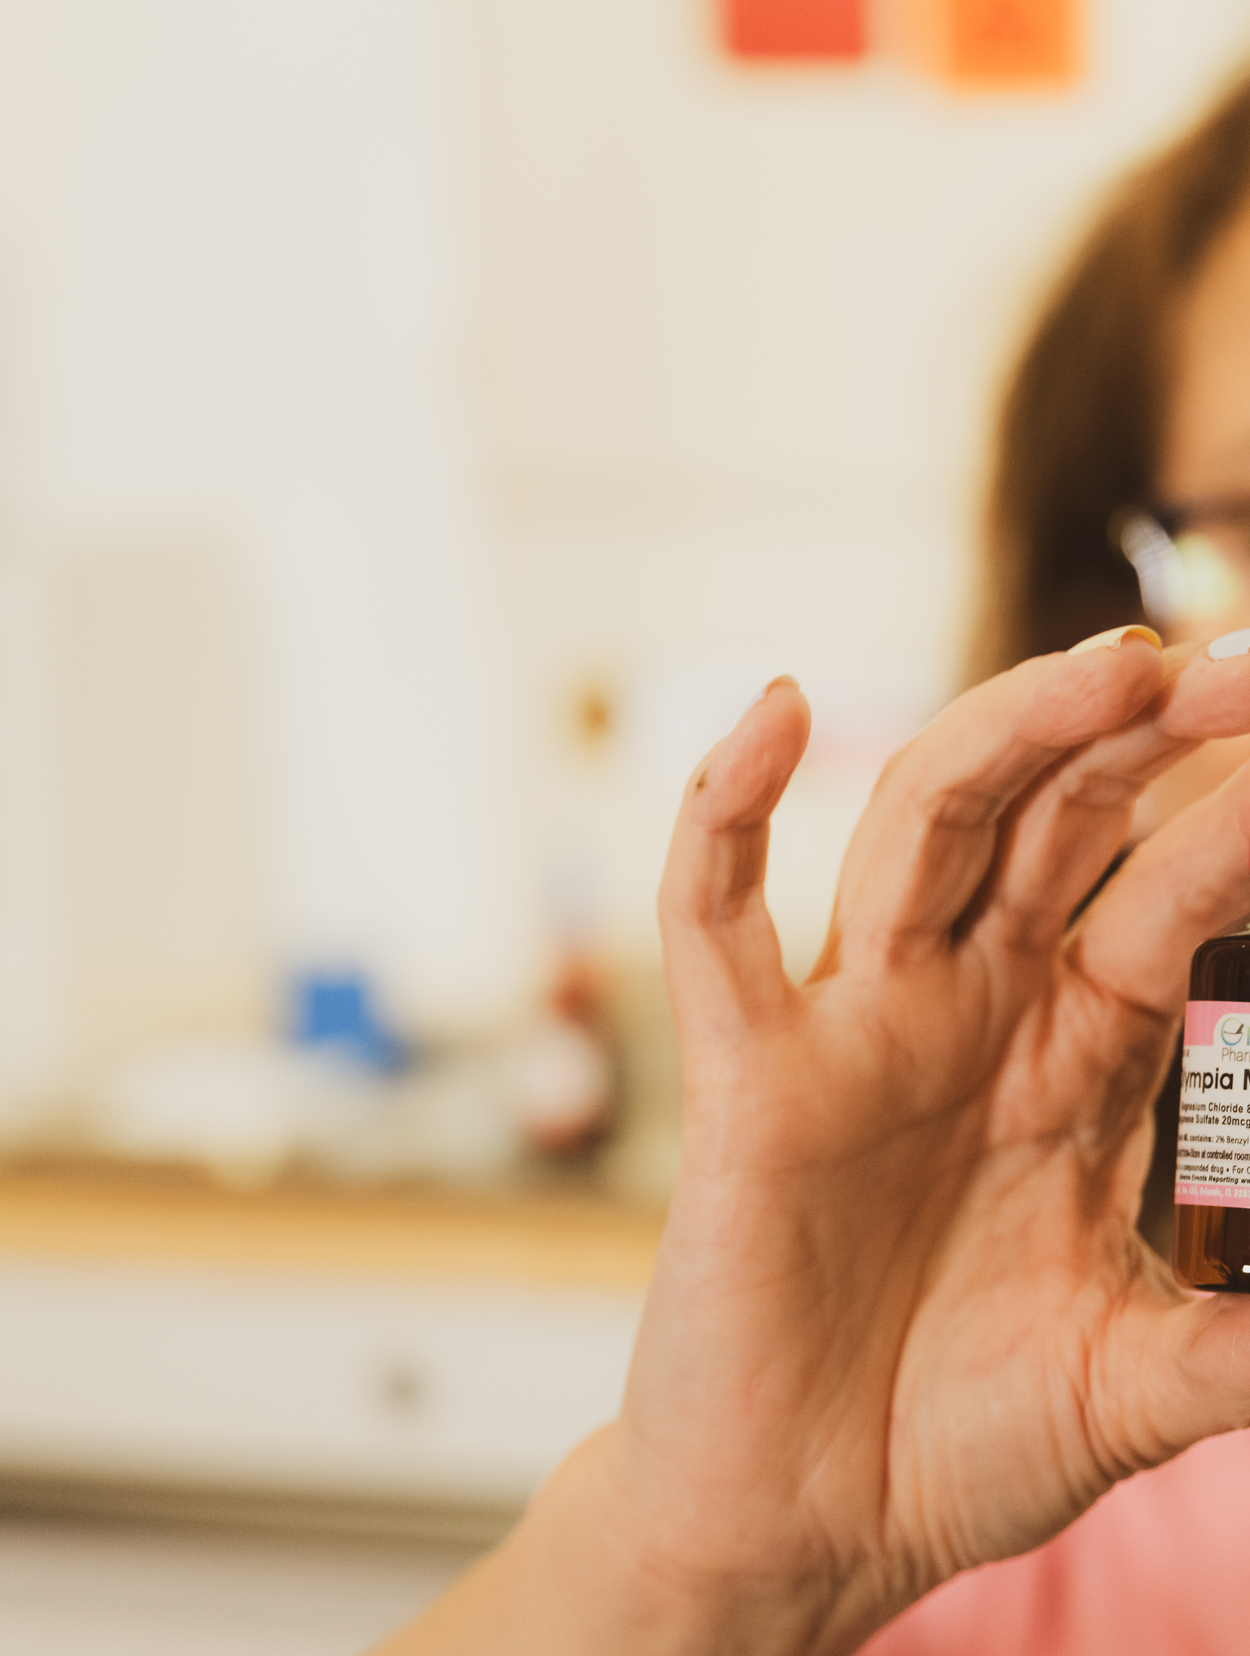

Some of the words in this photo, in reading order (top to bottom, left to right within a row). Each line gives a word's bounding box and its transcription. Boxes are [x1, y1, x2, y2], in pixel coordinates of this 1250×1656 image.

[1208, 1102, 1243, 1114] Chloride
[1195, 1114, 1219, 1125] Sulfate
[1189, 1134, 1214, 1143] contains:
[1215, 1135, 1225, 1143] 2%
[1226, 1136, 1249, 1146] Benzyl
[1207, 1150, 1233, 1160] controlled
[1234, 1152, 1250, 1161] room
[1210, 1164, 1224, 1175] drug
[1232, 1165, 1244, 1174] For
[1208, 1175, 1239, 1185] Reporting
[1199, 1187, 1224, 1198] Orlando,
[1225, 1188, 1232, 1197] FL
